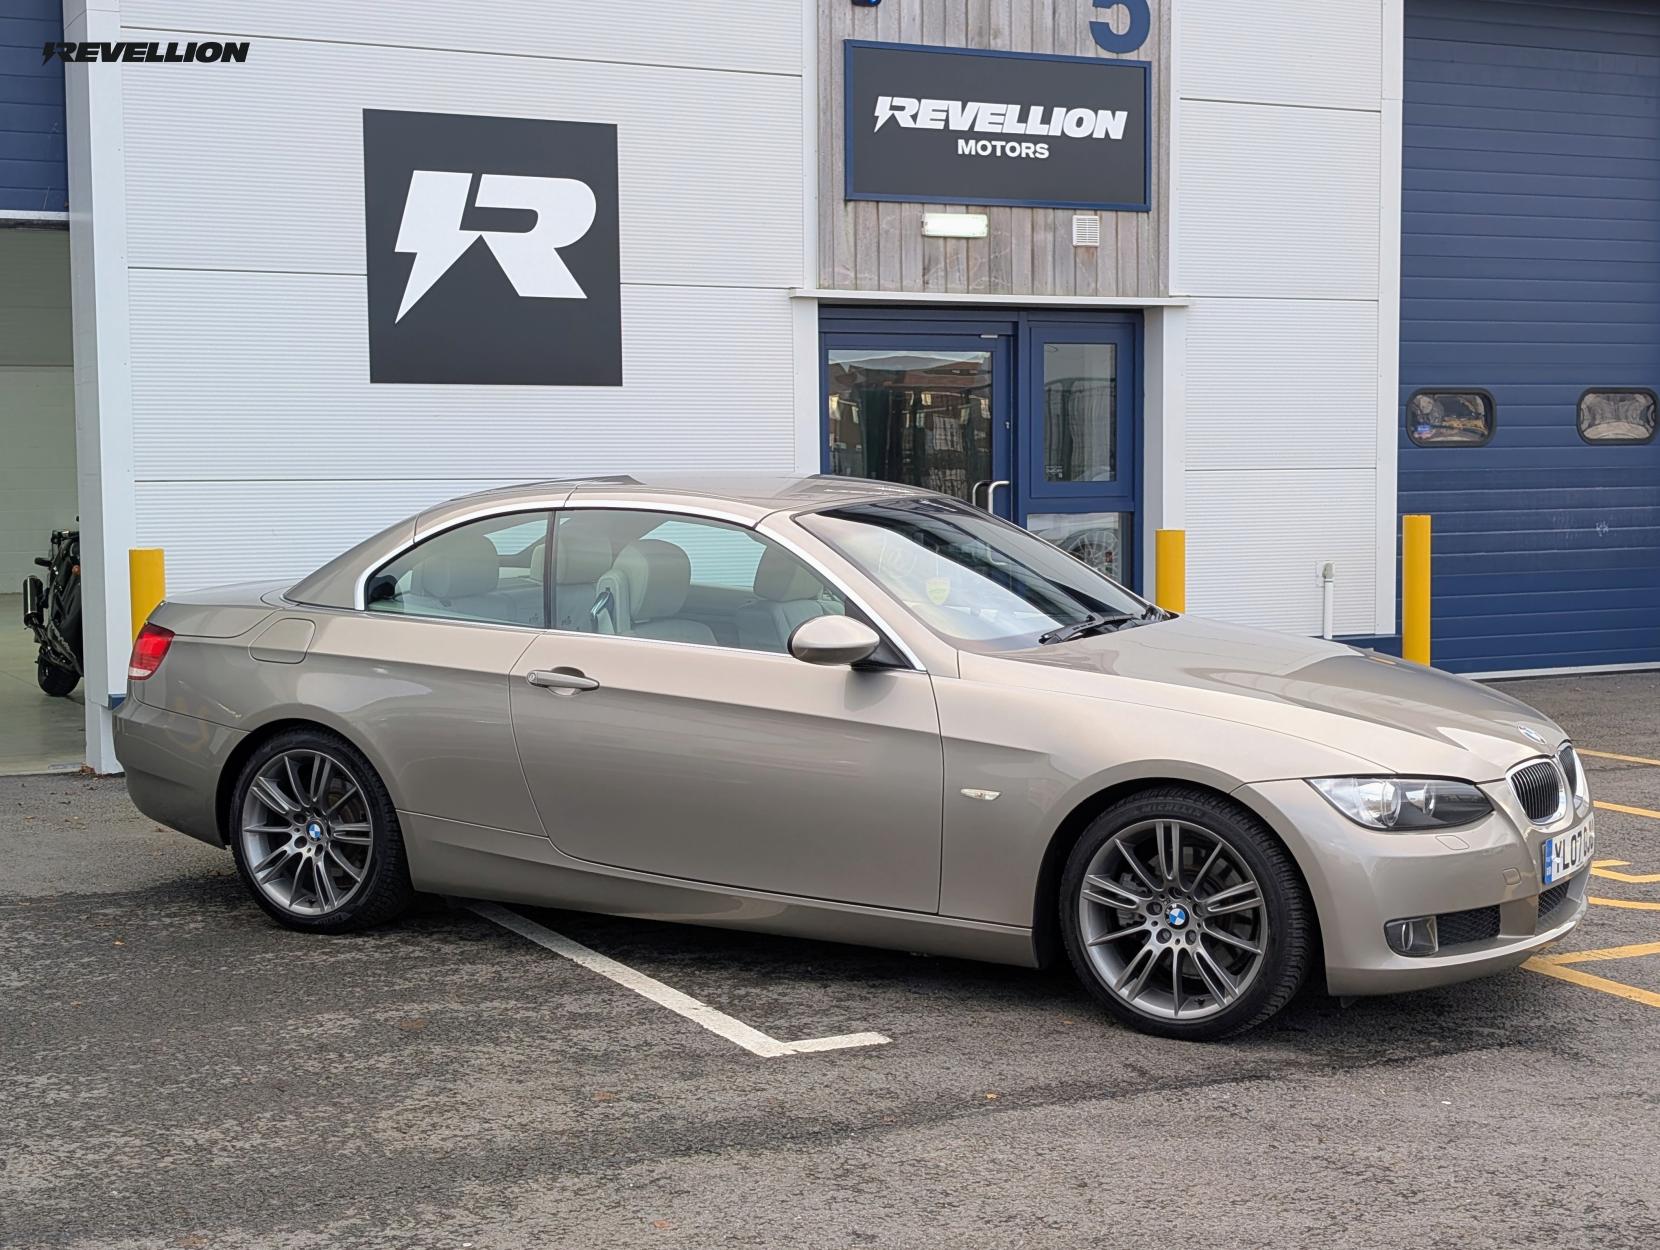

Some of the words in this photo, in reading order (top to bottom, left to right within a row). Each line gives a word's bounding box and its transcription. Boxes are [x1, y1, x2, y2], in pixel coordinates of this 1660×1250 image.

[1088, 0, 1150, 54] 5
[874, 95, 1128, 140] REVELLION
[957, 138, 1050, 159] MOTORS
[394, 169, 597, 325] R
